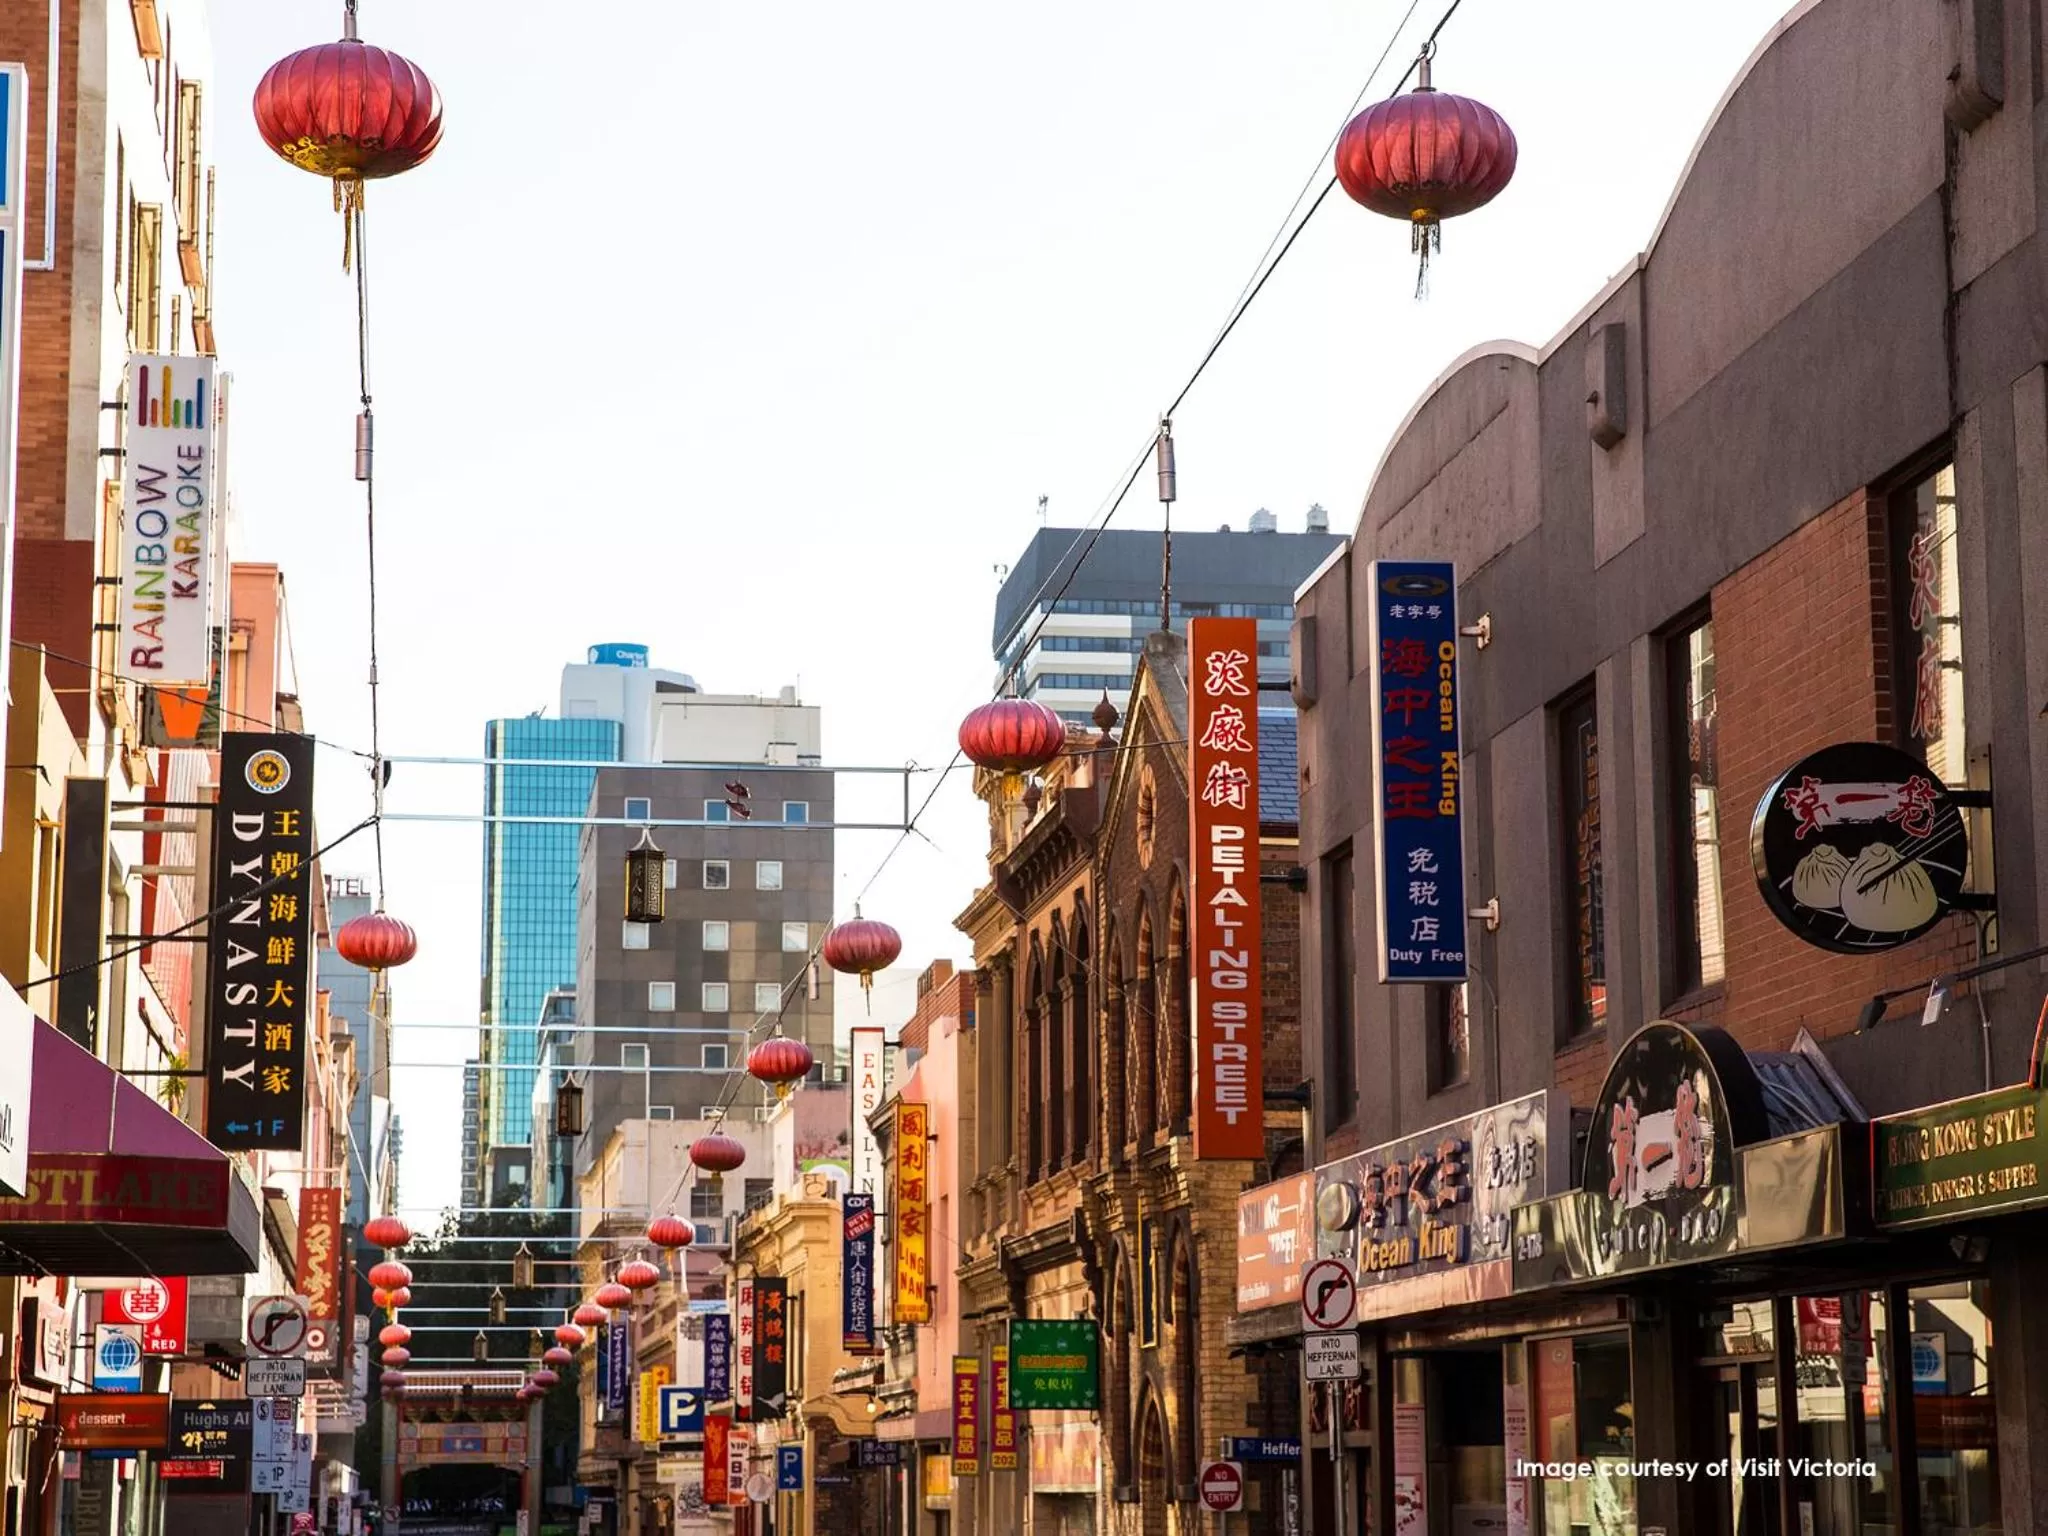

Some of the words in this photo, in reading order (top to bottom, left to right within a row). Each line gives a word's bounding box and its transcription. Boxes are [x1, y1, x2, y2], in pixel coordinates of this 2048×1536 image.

[172, 445, 205, 598] KARAOKE
[131, 464, 171, 669] RAINBOW
[1390, 604, 1442, 619] 老字号
[1438, 641, 1456, 732] Ocean
[1200, 650, 1254, 810] 茨廠街
[1382, 636, 1434, 819] 海中之王
[1438, 751, 1458, 816] King
[1208, 825, 1249, 990] PETALING
[1408, 847, 1441, 942] 免税店
[222, 810, 265, 1091] DYNASTY
[261, 809, 301, 1094] 王朝海鮮大酒家
[1390, 948, 1423, 964] Duty
[1432, 948, 1463, 962] Free
[1211, 1001, 1249, 1125] STREET
[1934, 1117, 1977, 1158] KONG
[1984, 1104, 2036, 1147] STYLE
[1932, 1174, 1976, 1203] DINNER
[1978, 1173, 1987, 1195] &
[1989, 1163, 2039, 1193] SUPPER
[899, 1241, 924, 1276] LING
[1359, 1235, 1411, 1273] Ocean
[1419, 1220, 1461, 1265] King
[900, 1272, 923, 1300] NAN
[151, 1339, 177, 1350] RED
[1307, 1352, 1356, 1363] HEFFERNAN
[1321, 1339, 1340, 1349] INTO
[250, 1373, 302, 1382] HEFFERNAN
[266, 1361, 287, 1370] INTO
[1319, 1364, 1344, 1376] LANE
[263, 1384, 287, 1394] LANE
[79, 1411, 126, 1425] dessert
[184, 1411, 229, 1428] Hughs
[669, 1391, 698, 1428] P
[783, 1451, 798, 1470] P
[992, 1455, 1014, 1466] 202
[1214, 1471, 1228, 1481] NO
[1207, 1492, 1237, 1503] ENTRY
